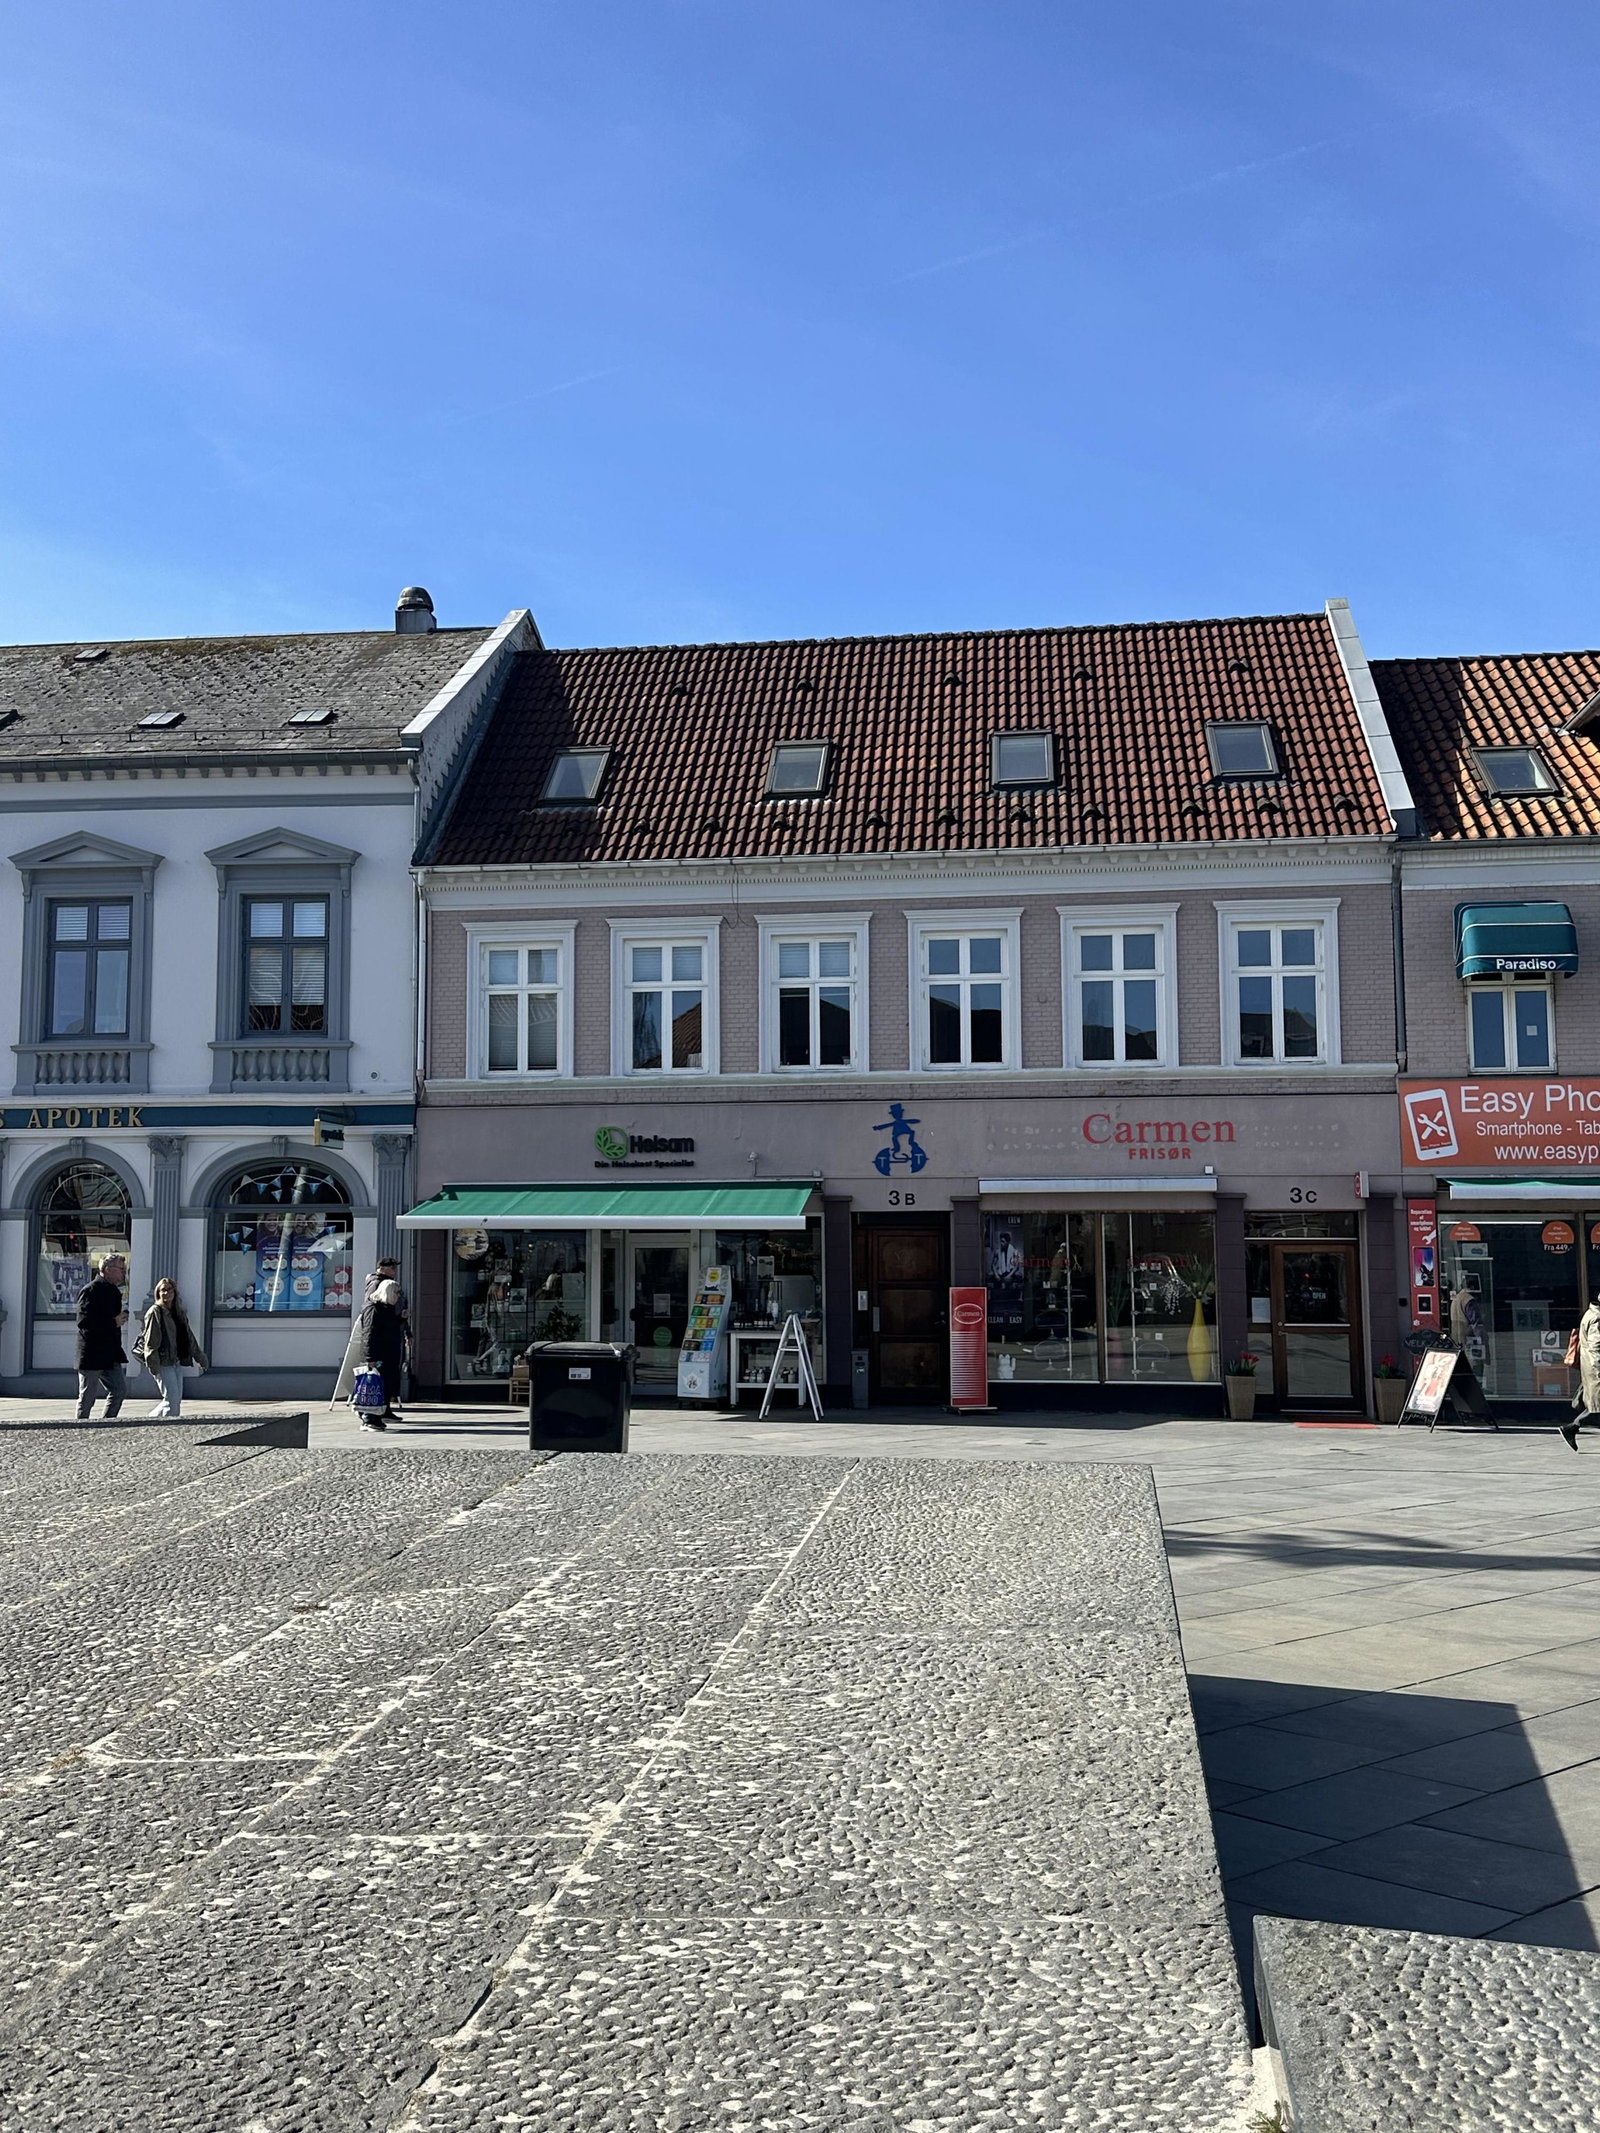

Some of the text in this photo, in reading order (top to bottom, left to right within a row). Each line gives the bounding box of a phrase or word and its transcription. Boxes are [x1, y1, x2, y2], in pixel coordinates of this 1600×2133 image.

[1496, 958, 1557, 970] Paradiso
[1460, 1084, 1600, 1119] Easy Pho
[27, 1106, 144, 1129] APOTEK
[1082, 1113, 1237, 1144] Carmen
[1476, 1120, 1562, 1138] Smartphone
[630, 1134, 695, 1153] Helsam
[1128, 1147, 1192, 1160] FRISØR
